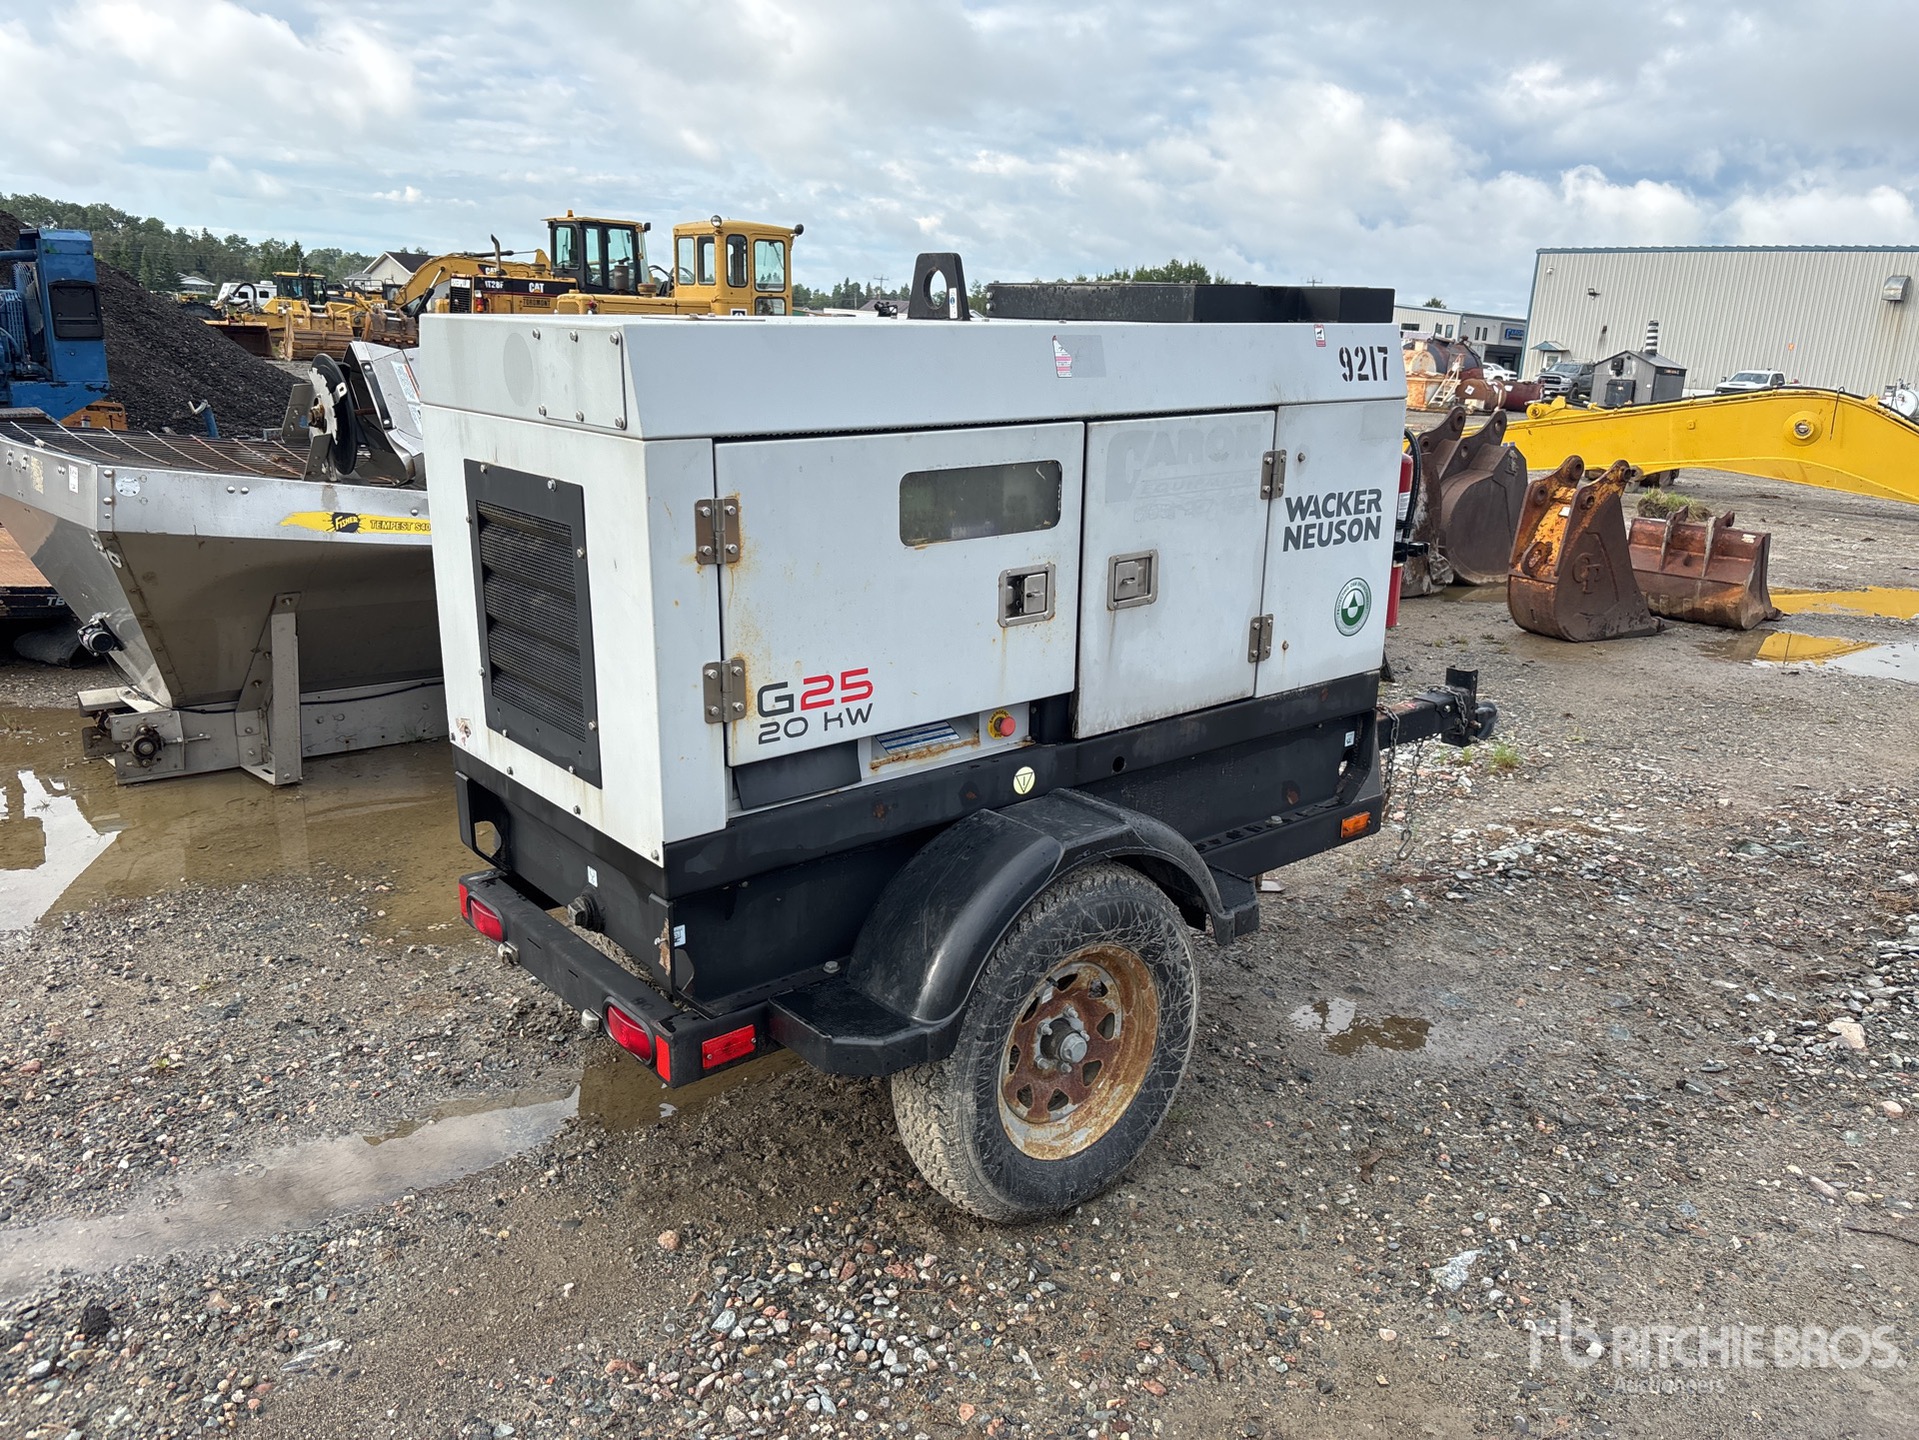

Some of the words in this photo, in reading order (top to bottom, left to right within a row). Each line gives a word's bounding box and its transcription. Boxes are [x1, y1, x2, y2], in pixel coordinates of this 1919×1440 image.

[529, 282, 544, 293] CAT
[1338, 345, 1388, 382] 9217
[1285, 488, 1382, 523] WACKER
[370, 520, 412, 531] TEMPEST
[1282, 515, 1382, 552] NEUSON
[757, 667, 874, 718] G25
[758, 716, 809, 745] 20
